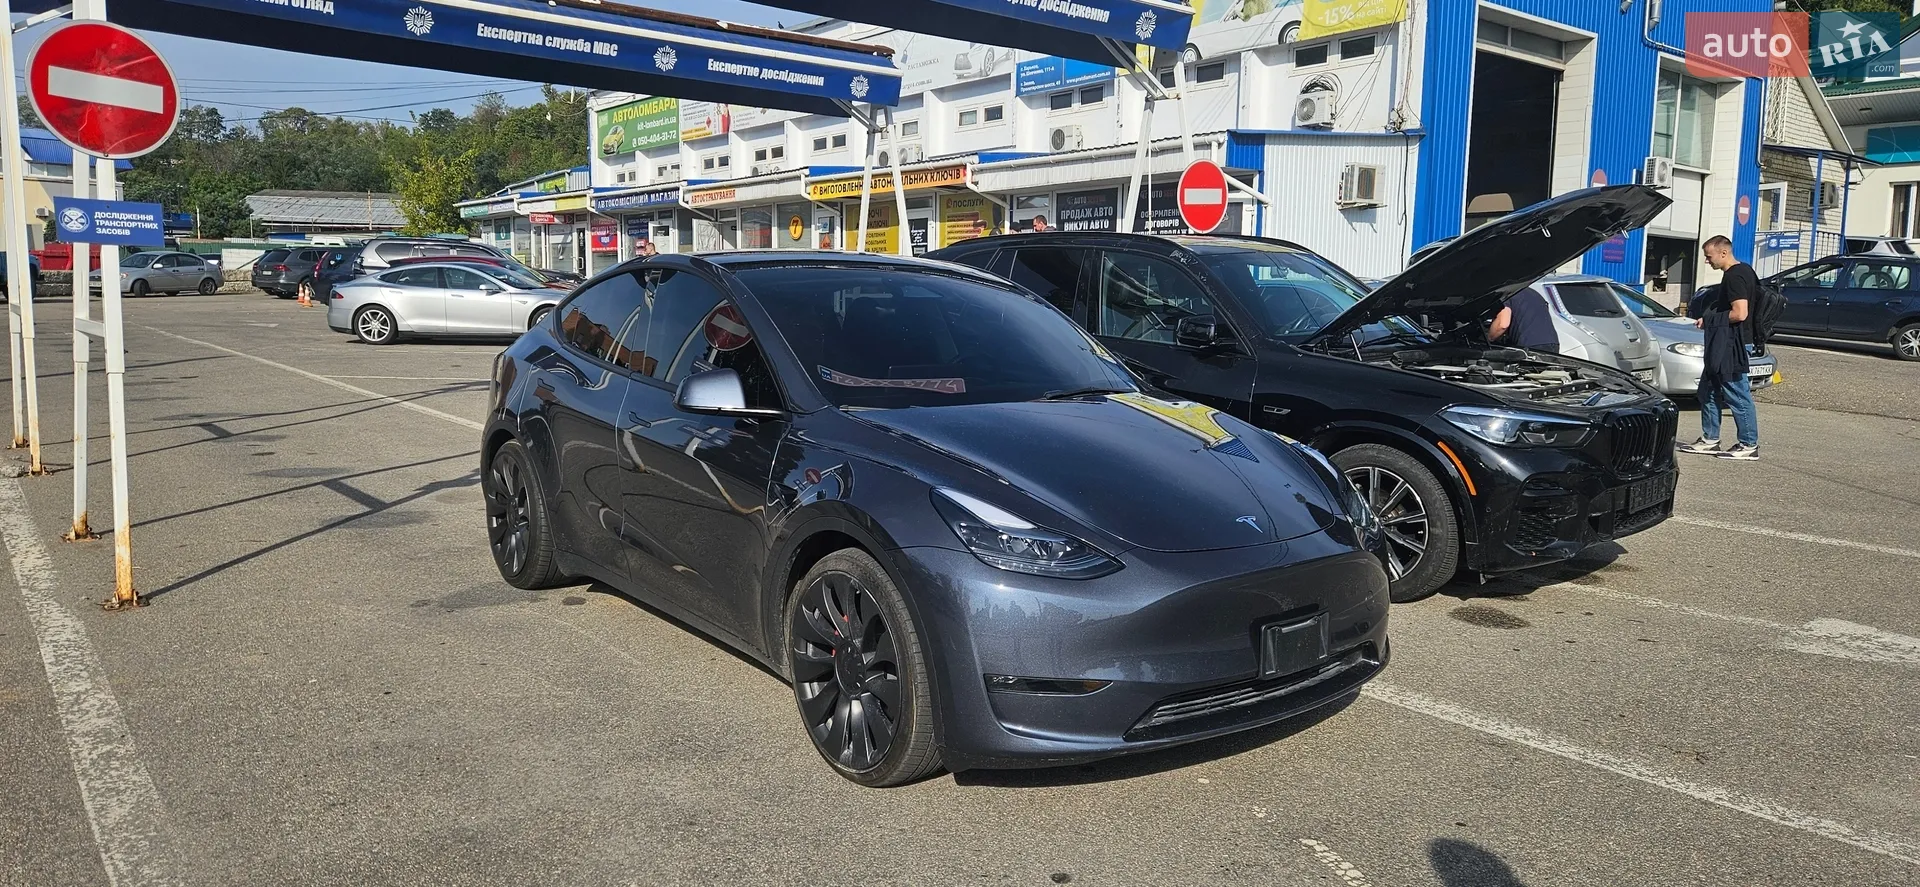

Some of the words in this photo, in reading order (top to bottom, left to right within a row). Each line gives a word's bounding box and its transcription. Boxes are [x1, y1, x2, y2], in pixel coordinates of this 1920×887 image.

[477, 23, 543, 46] Експертна
[545, 35, 591, 53] служба
[593, 41, 619, 57] МВС
[708, 58, 760, 77] Експертне
[760, 68, 825, 86] дослідження
[612, 98, 677, 124] АВТОЛОМБАРД
[819, 181, 864, 196] ВИГОТОВЛЕНН
[930, 168, 961, 183] КЛЮЧІВ
[952, 199, 984, 208] ПОСЛУГИ
[94, 211, 154, 221] ДОСЛІДЖЕННЯ
[1060, 208, 1093, 220] ПРОДАЖ
[1093, 206, 1114, 217] АВТО
[95, 219, 159, 230] ТРАНСПОРТНИХ
[1063, 221, 1089, 231] ВИКУП
[1089, 219, 1110, 230] АВТО
[96, 227, 131, 236] ЗАСОБІВ
